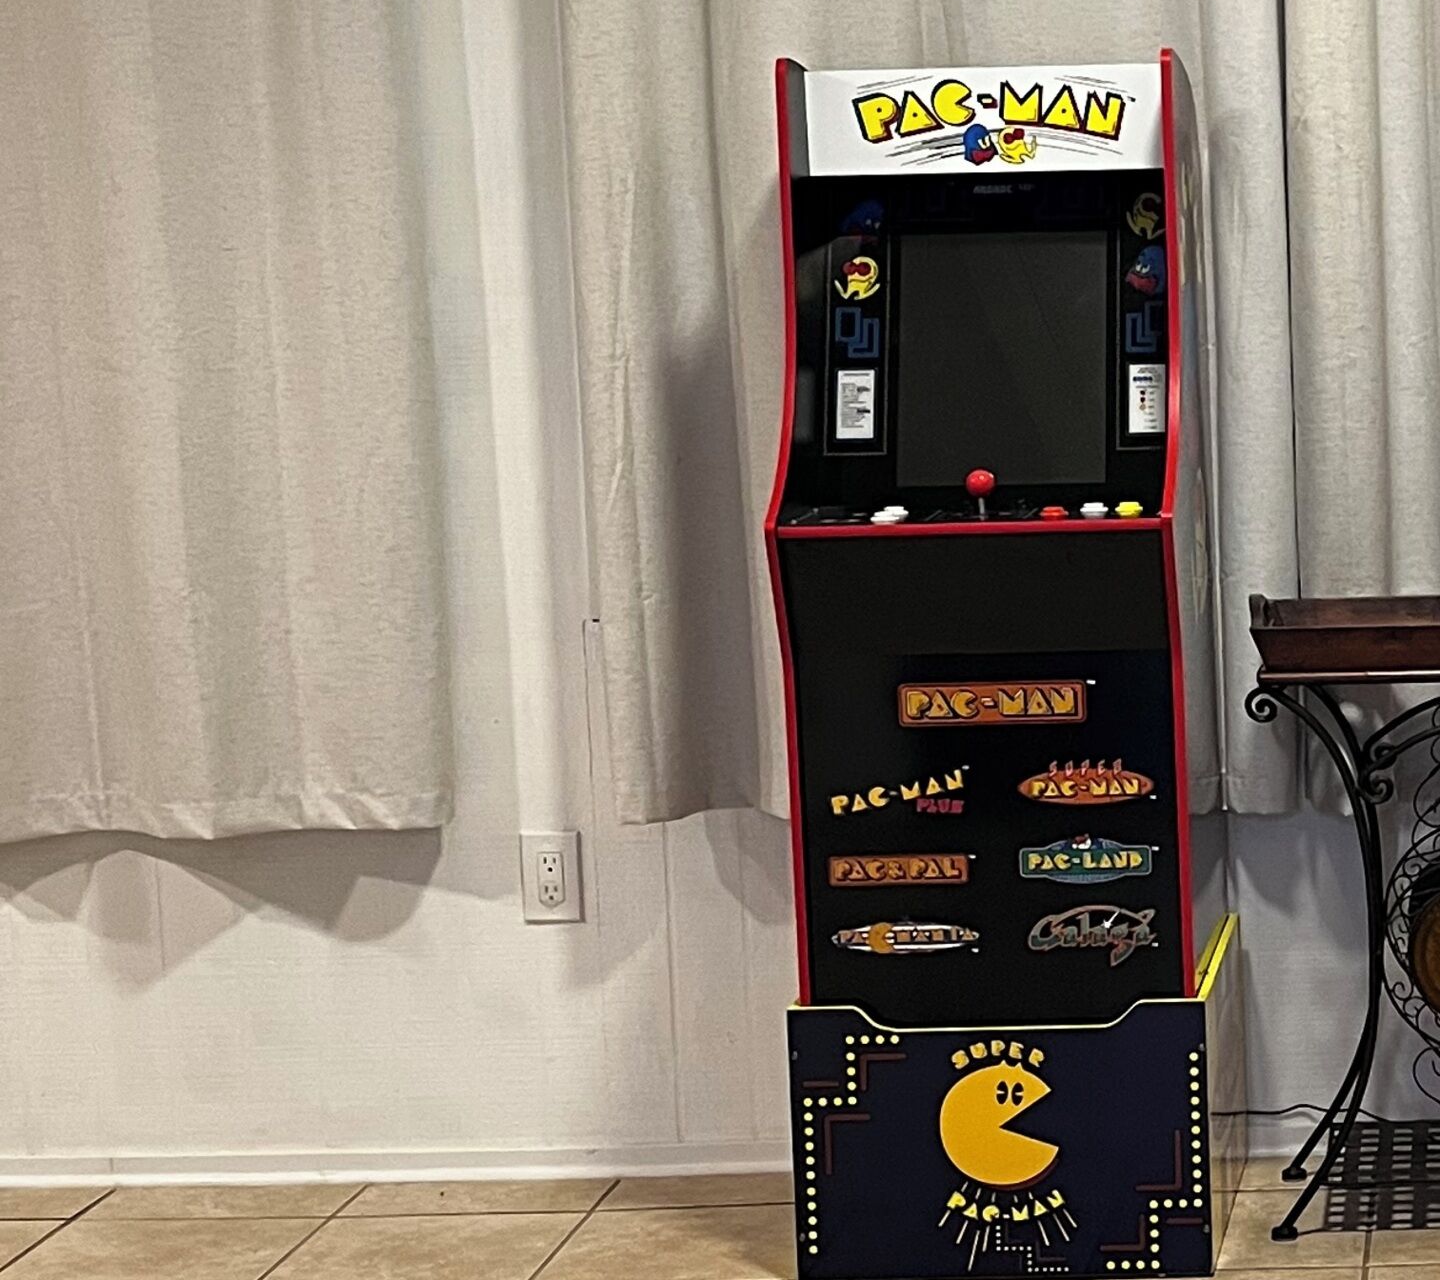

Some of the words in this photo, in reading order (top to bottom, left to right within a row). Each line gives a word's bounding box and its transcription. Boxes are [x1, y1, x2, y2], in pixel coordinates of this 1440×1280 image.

[852, 79, 1126, 144] PAC-MAN
[904, 686, 1078, 719] PAC-MAN
[1048, 758, 1123, 777] SUPER
[830, 768, 964, 815] PAC-MAN
[1029, 777, 1142, 798] PAC-MAN
[1027, 850, 1145, 871] PAC-LAND
[951, 1040, 1045, 1069] SUPER
[946, 1189, 1065, 1222] PAC-MAN
